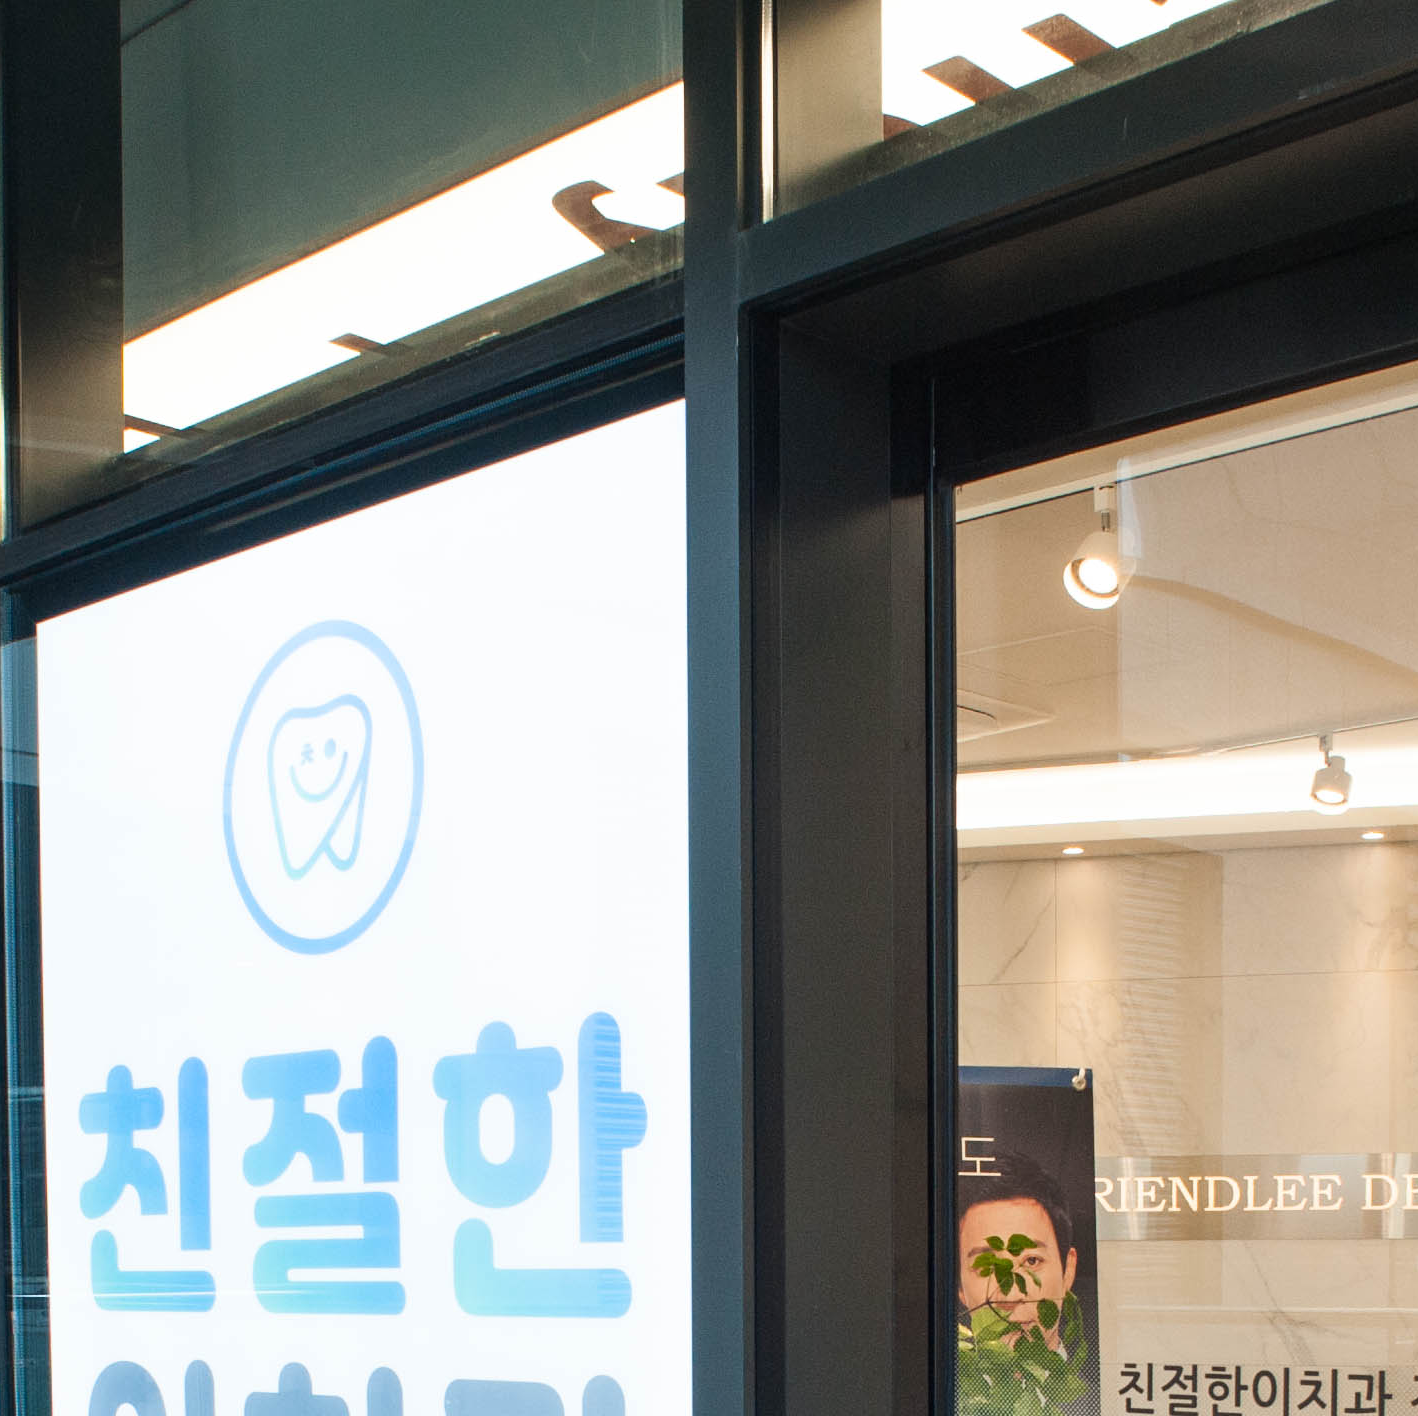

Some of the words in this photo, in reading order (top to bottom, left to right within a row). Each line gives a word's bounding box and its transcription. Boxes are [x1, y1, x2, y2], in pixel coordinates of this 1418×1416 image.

[78, 1010, 648, 1318] 친절한
[957, 1136, 1002, 1177] 도
[1094, 1174, 1344, 1213] RIENDLEE
